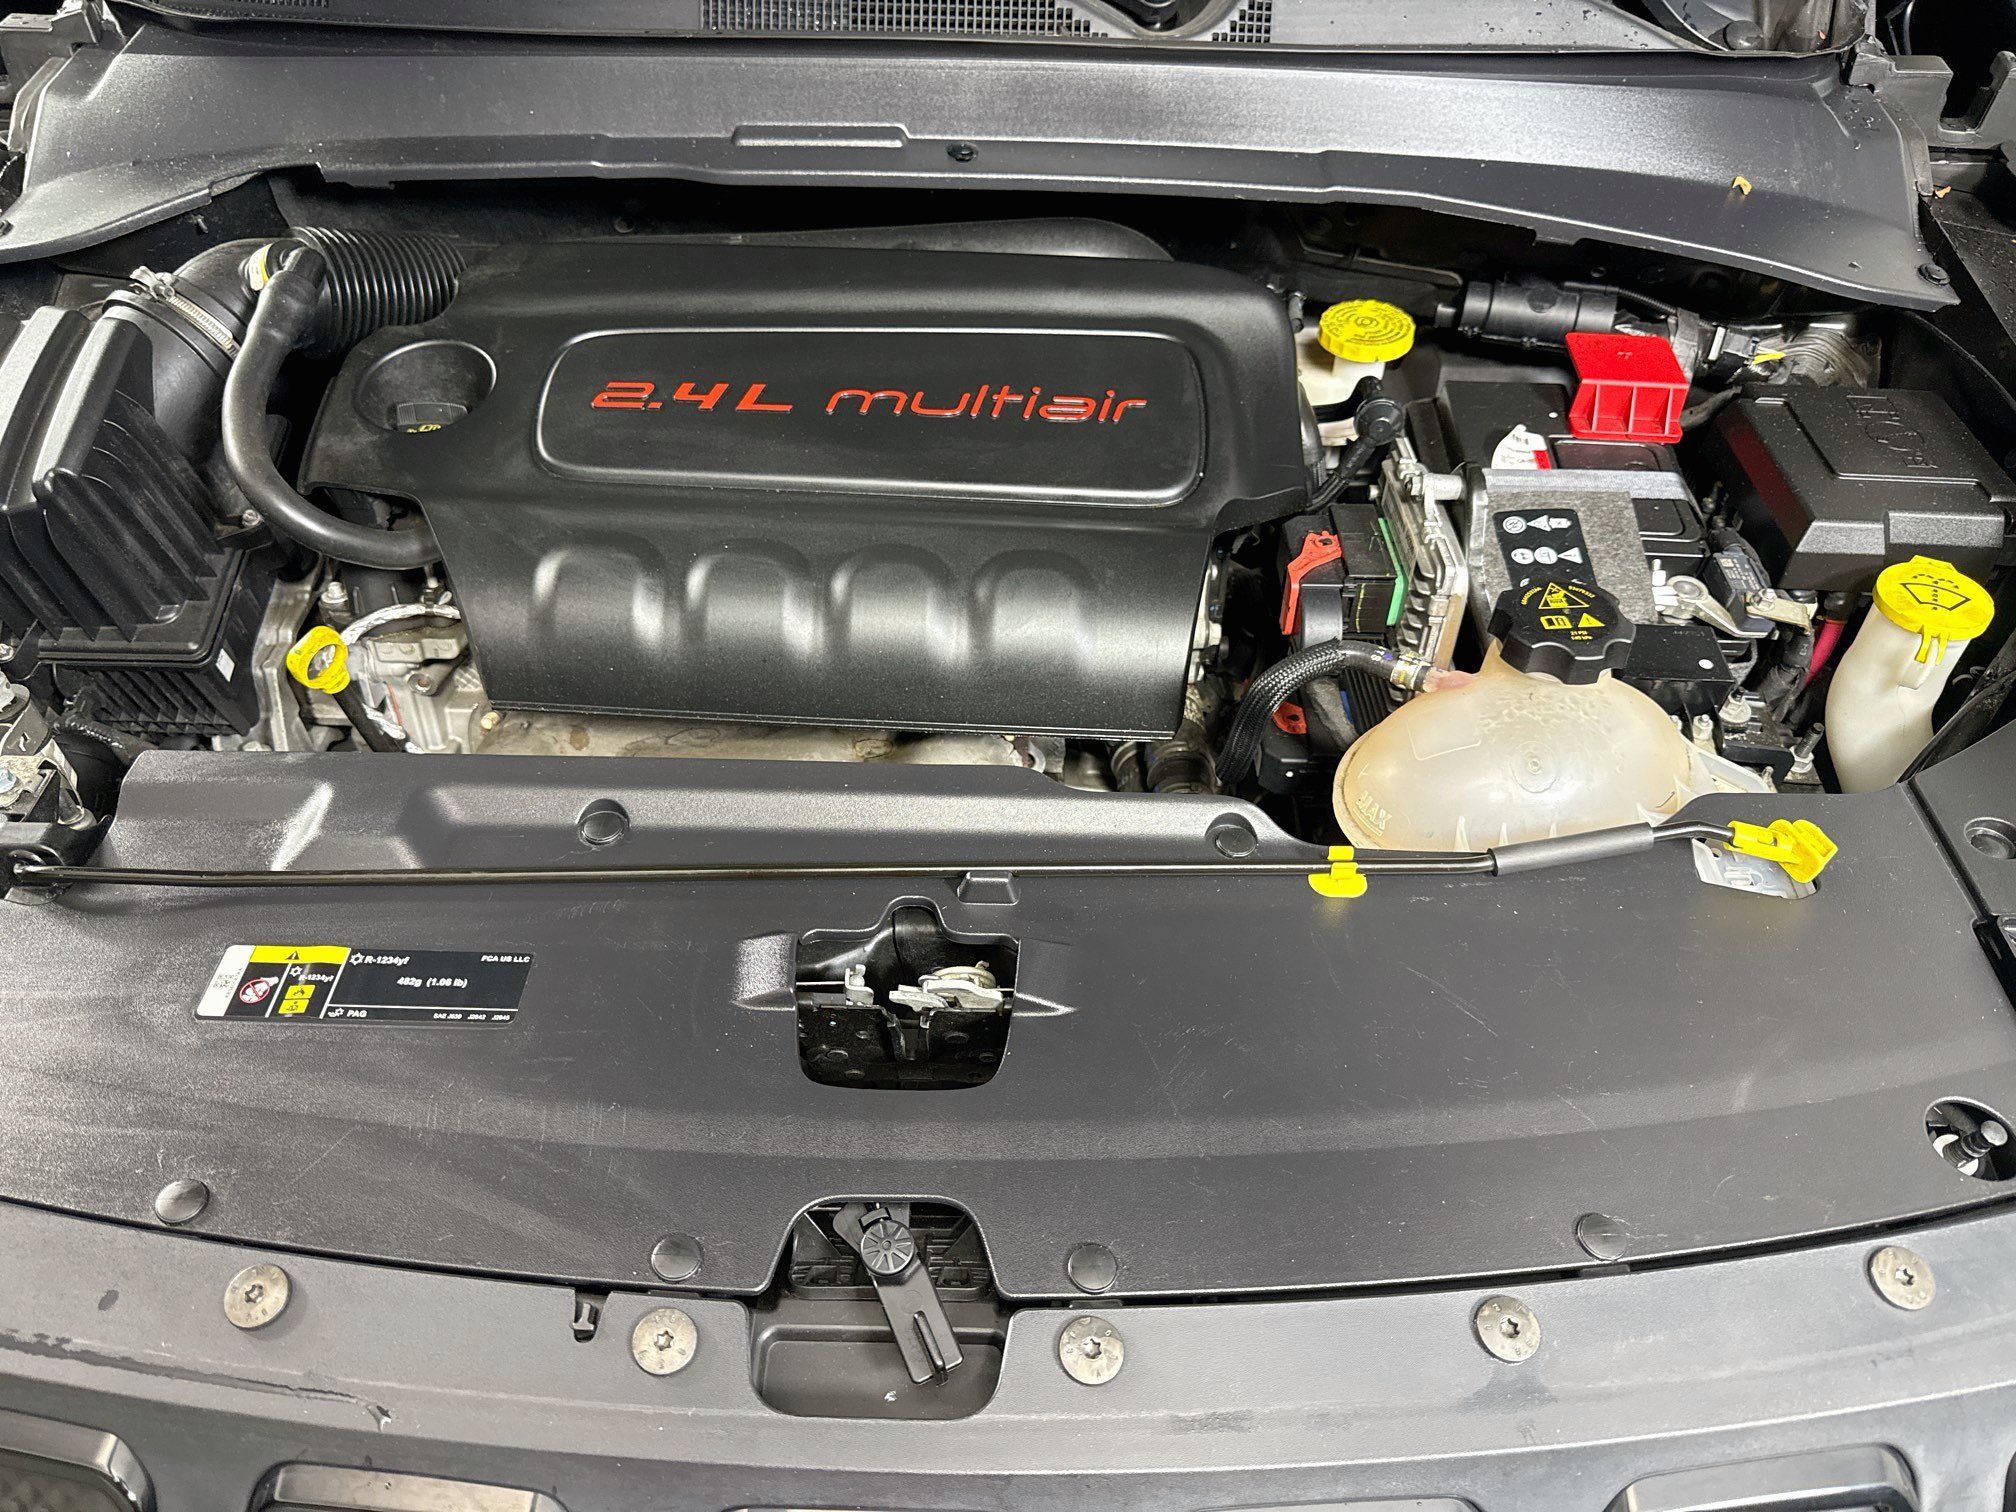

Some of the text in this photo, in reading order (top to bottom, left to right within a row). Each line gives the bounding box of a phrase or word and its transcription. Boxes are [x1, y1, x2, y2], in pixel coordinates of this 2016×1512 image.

[591, 381, 1148, 423] 2.4L multiair
[364, 955, 410, 965] R-1234yf
[480, 955, 499, 963] FCA
[513, 956, 531, 964] LLC
[346, 1009, 368, 1019] PAG
